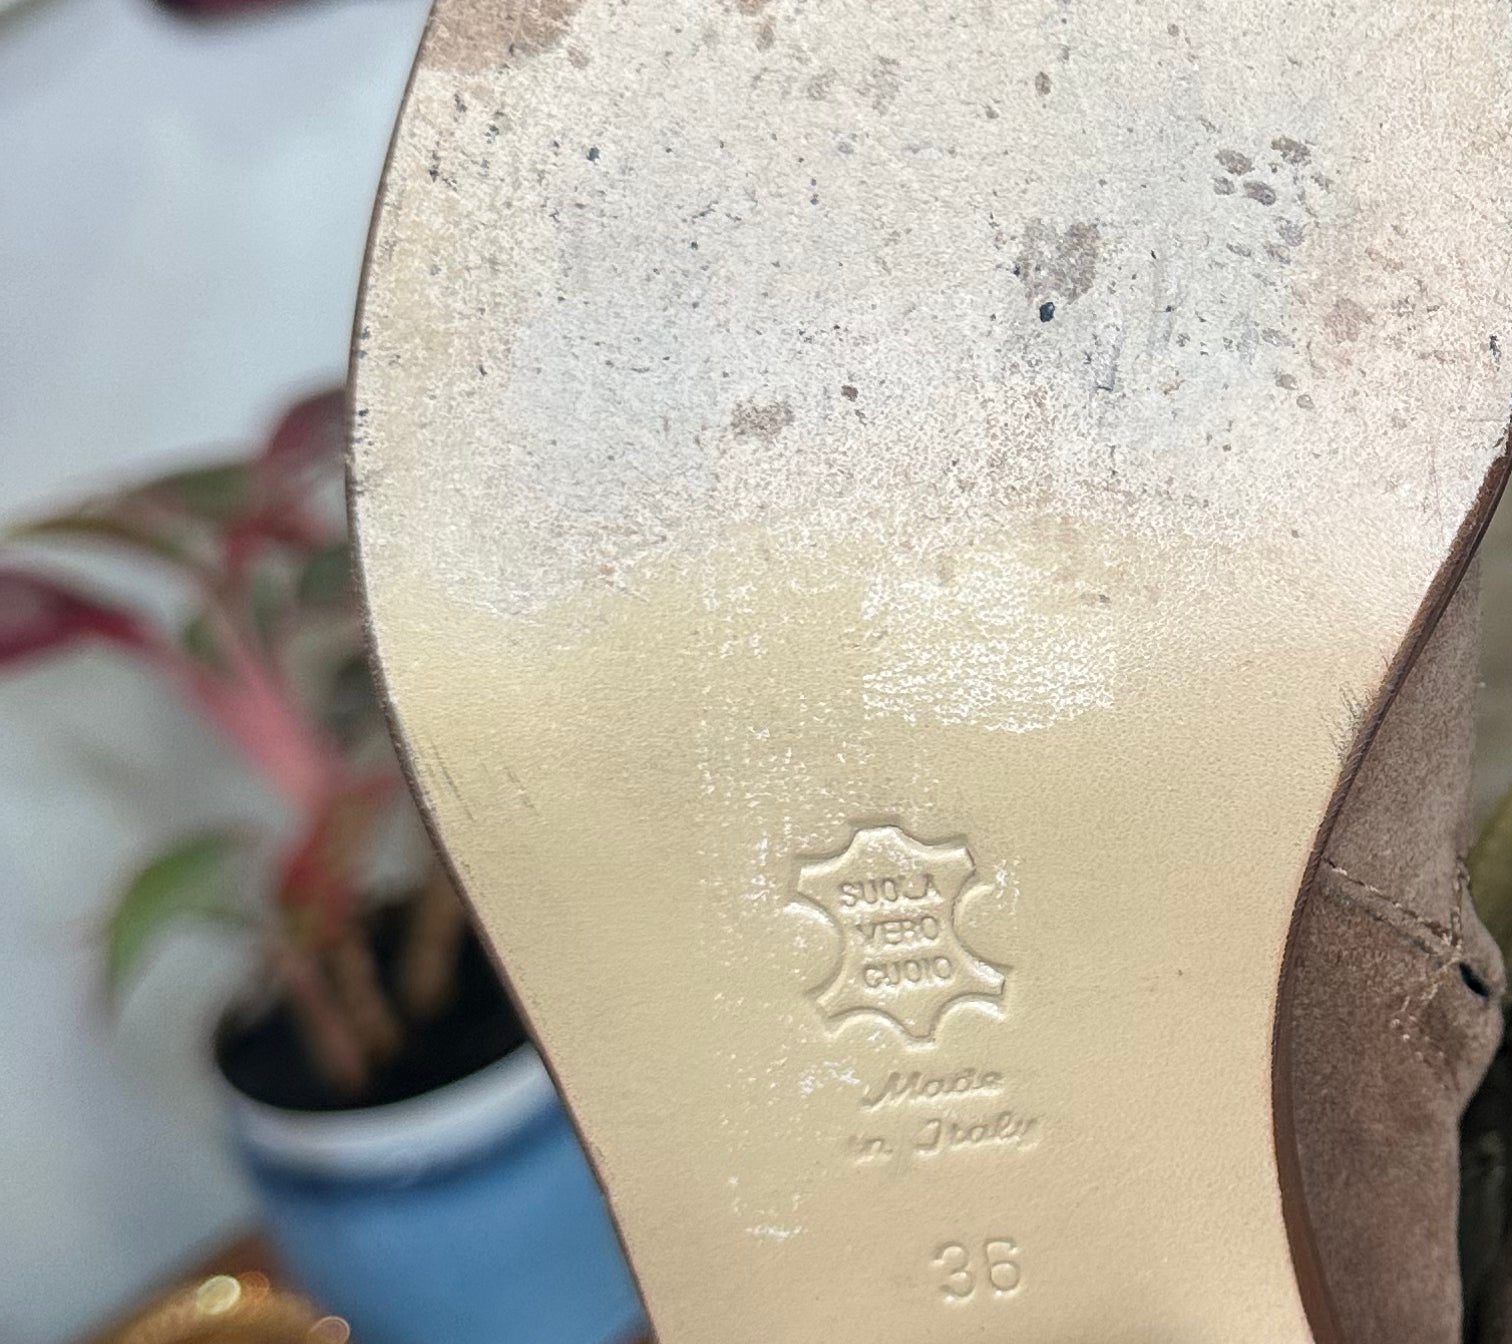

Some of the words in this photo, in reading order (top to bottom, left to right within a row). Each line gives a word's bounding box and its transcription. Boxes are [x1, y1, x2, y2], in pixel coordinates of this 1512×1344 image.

[839, 872, 942, 908] SUOLA
[854, 914, 940, 946] VERO
[862, 955, 952, 989] CUOIO
[856, 1066, 1005, 1110] Made
[912, 1109, 1041, 1154] Italy
[930, 1238, 1024, 1302] 36
